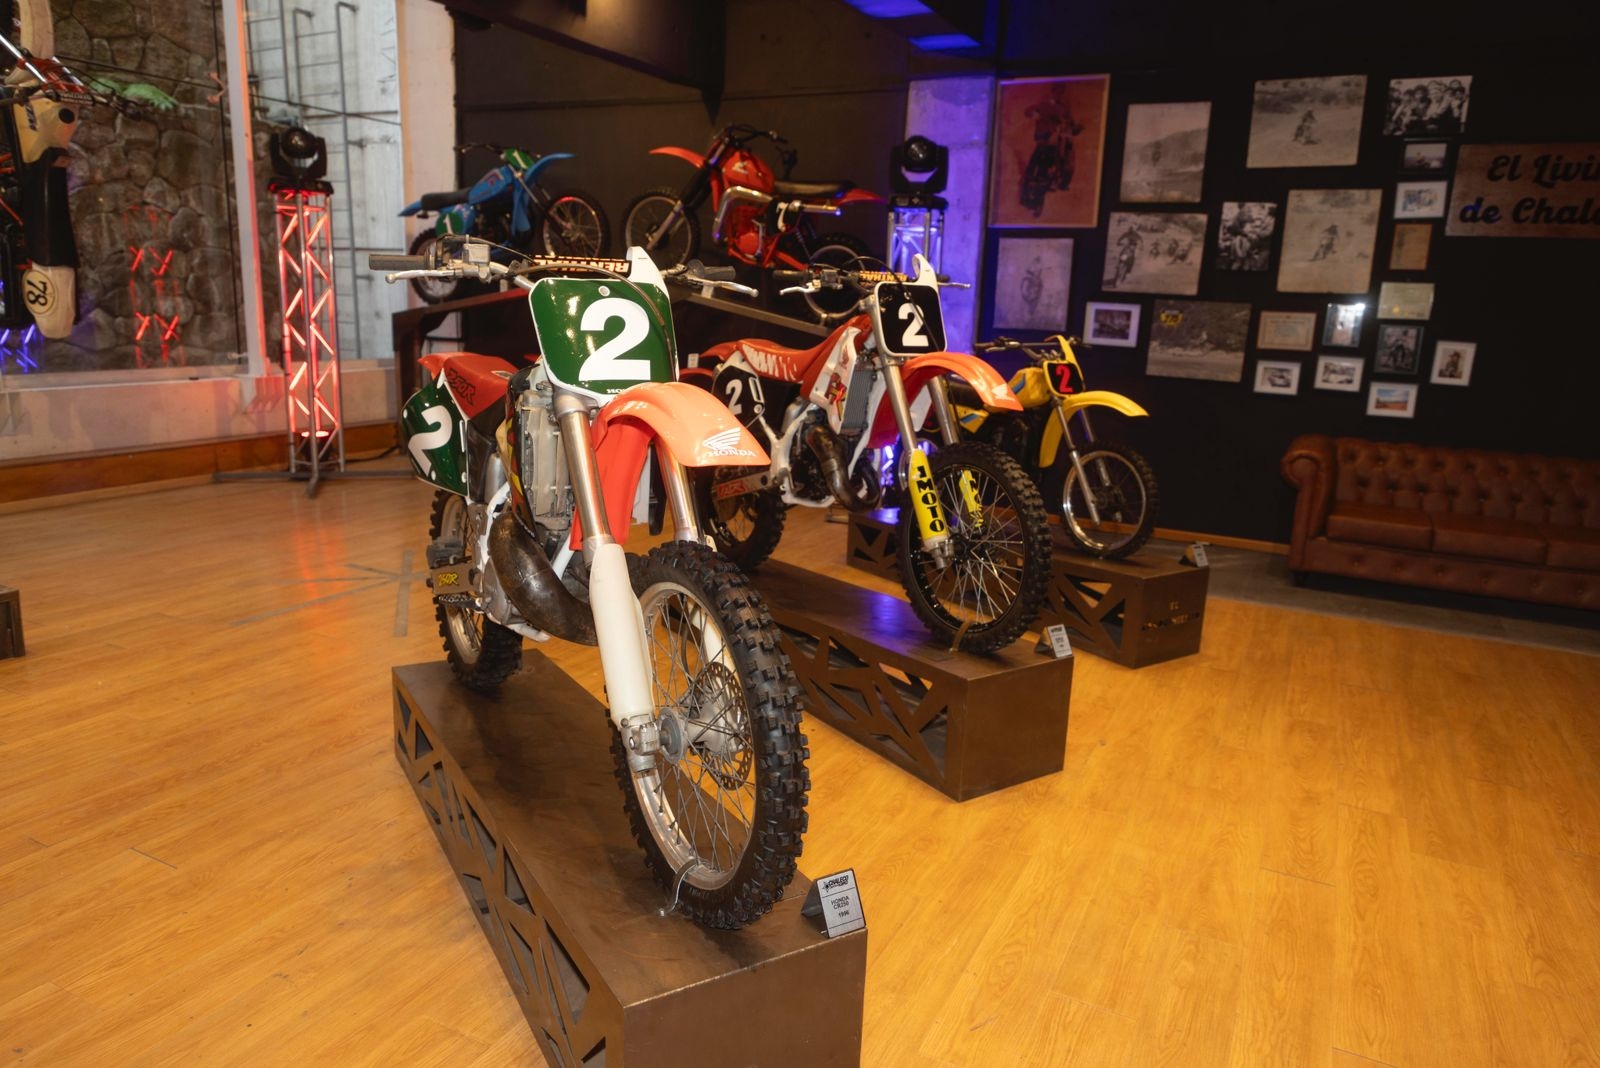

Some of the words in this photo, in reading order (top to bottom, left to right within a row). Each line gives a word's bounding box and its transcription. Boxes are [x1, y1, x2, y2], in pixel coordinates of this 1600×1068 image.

[1487, 154, 1523, 182] El
[1532, 153, 1600, 189] Livi
[1460, 197, 1501, 223] de
[26, 279, 48, 306] 78
[578, 297, 651, 382] 2
[898, 302, 929, 347] 2
[1055, 365, 1073, 393] 2
[725, 378, 743, 415] 2
[407, 404, 453, 478] 2
[706, 448, 758, 458] HONDA
[830, 895, 850, 906] HONDA
